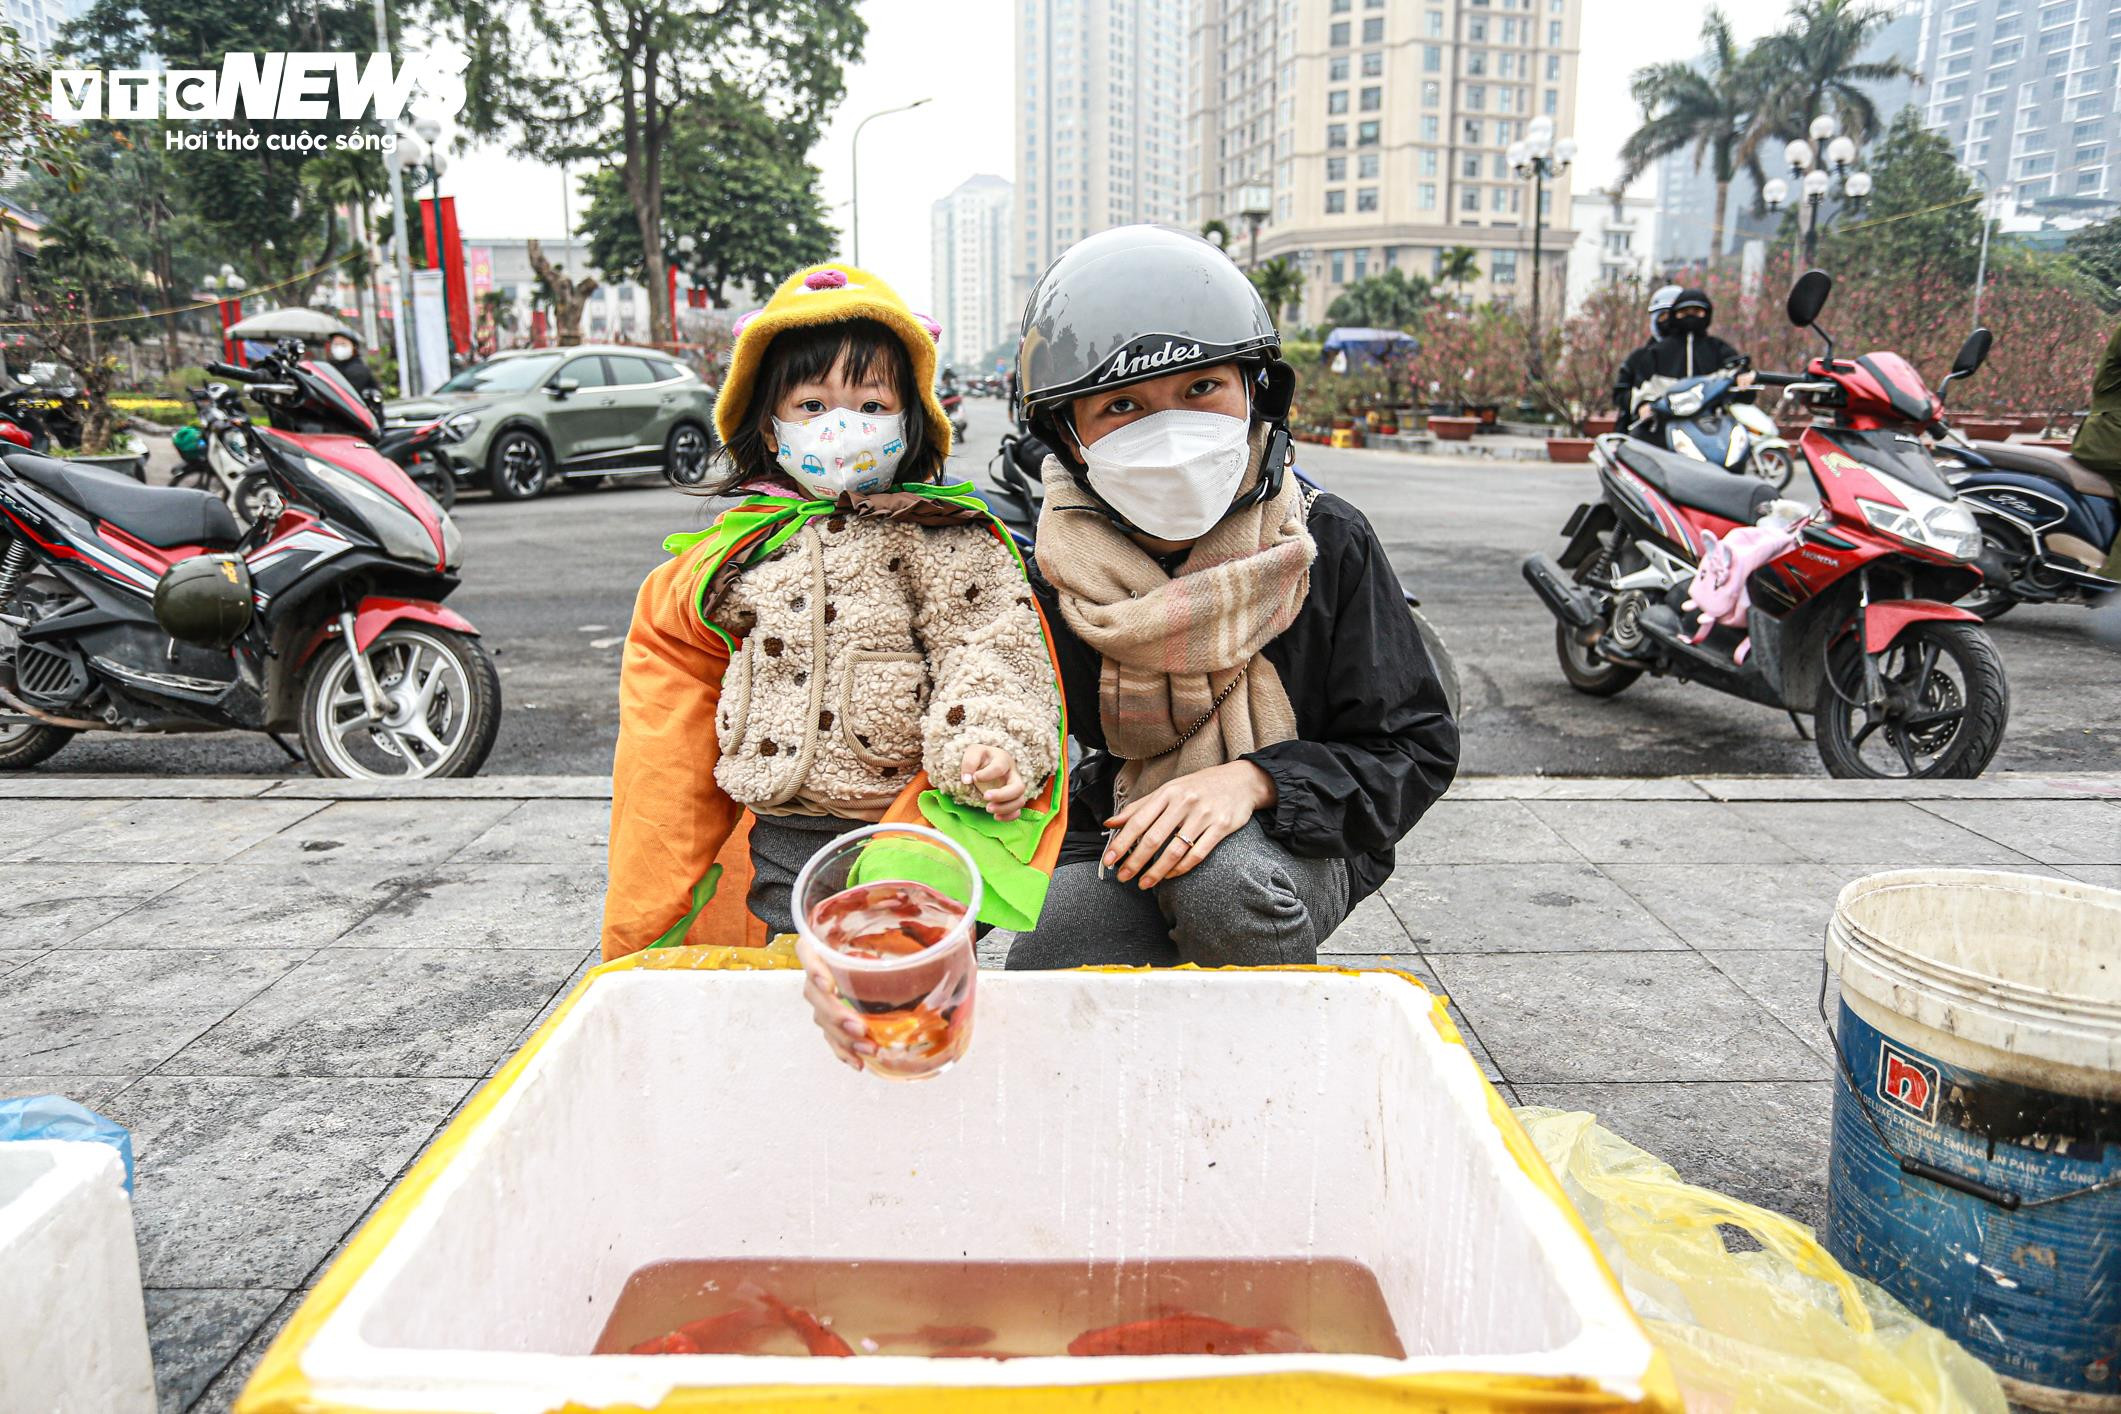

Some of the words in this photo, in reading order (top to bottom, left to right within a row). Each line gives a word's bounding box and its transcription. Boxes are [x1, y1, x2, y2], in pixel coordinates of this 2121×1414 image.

[1097, 341, 1203, 383] Andes
[1802, 550, 1840, 568] HONDA
[1862, 1093, 1892, 1120] DELUXE
[1893, 1113, 1941, 1143] EXTERIOR
[1943, 1137, 2007, 1167] EMULSIN
[2008, 1159, 2048, 1177] PAINT
